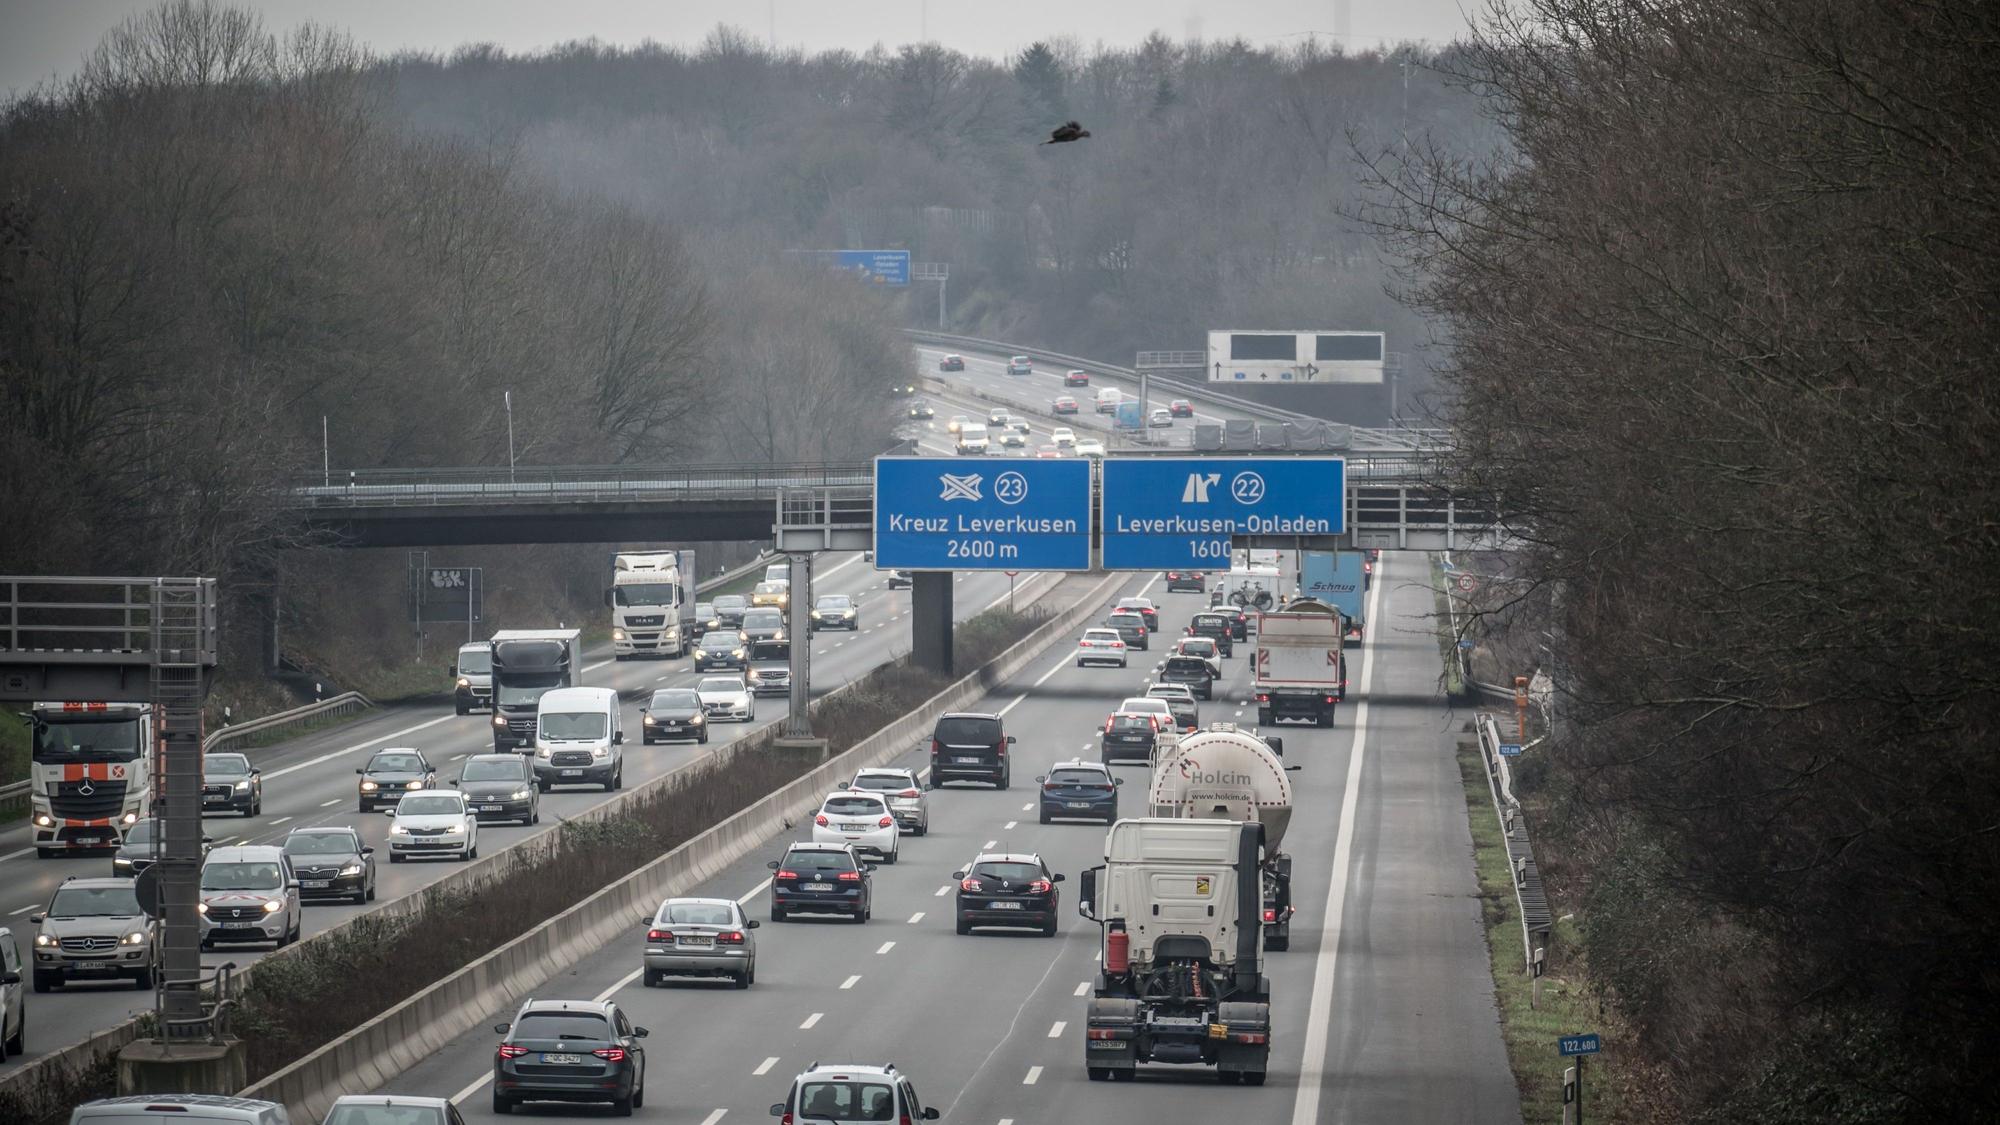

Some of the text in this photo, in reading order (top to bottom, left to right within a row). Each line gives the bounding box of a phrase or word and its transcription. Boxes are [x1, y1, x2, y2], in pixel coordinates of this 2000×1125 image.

[999, 478, 1023, 497] 23
[1236, 479, 1260, 497] 22
[889, 514, 1076, 533] Kreuz Leverkusen
[1117, 515, 1329, 534] Leverkusen-Opladen
[947, 540, 1018, 558] 2600 m
[1190, 540, 1232, 558] 1600
[1191, 770, 1251, 785] Holcim
[1191, 792, 1251, 801] www.holcim.de
